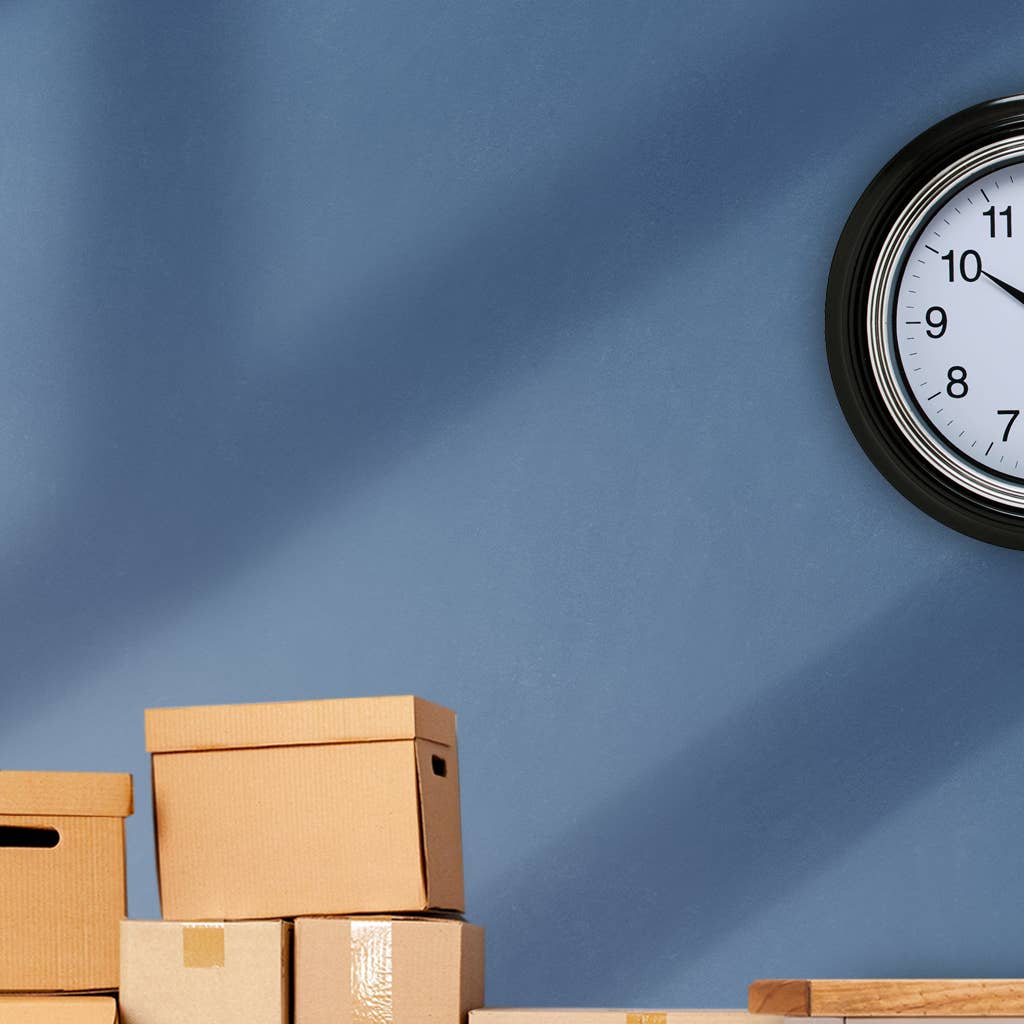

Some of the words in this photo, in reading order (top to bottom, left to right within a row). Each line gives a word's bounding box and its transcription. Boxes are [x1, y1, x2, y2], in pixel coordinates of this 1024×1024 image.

[982, 205, 1013, 238] 11
[941, 249, 982, 282] 10
[925, 306, 948, 339] 9
[946, 366, 969, 399] 8
[997, 409, 1020, 442] 7
